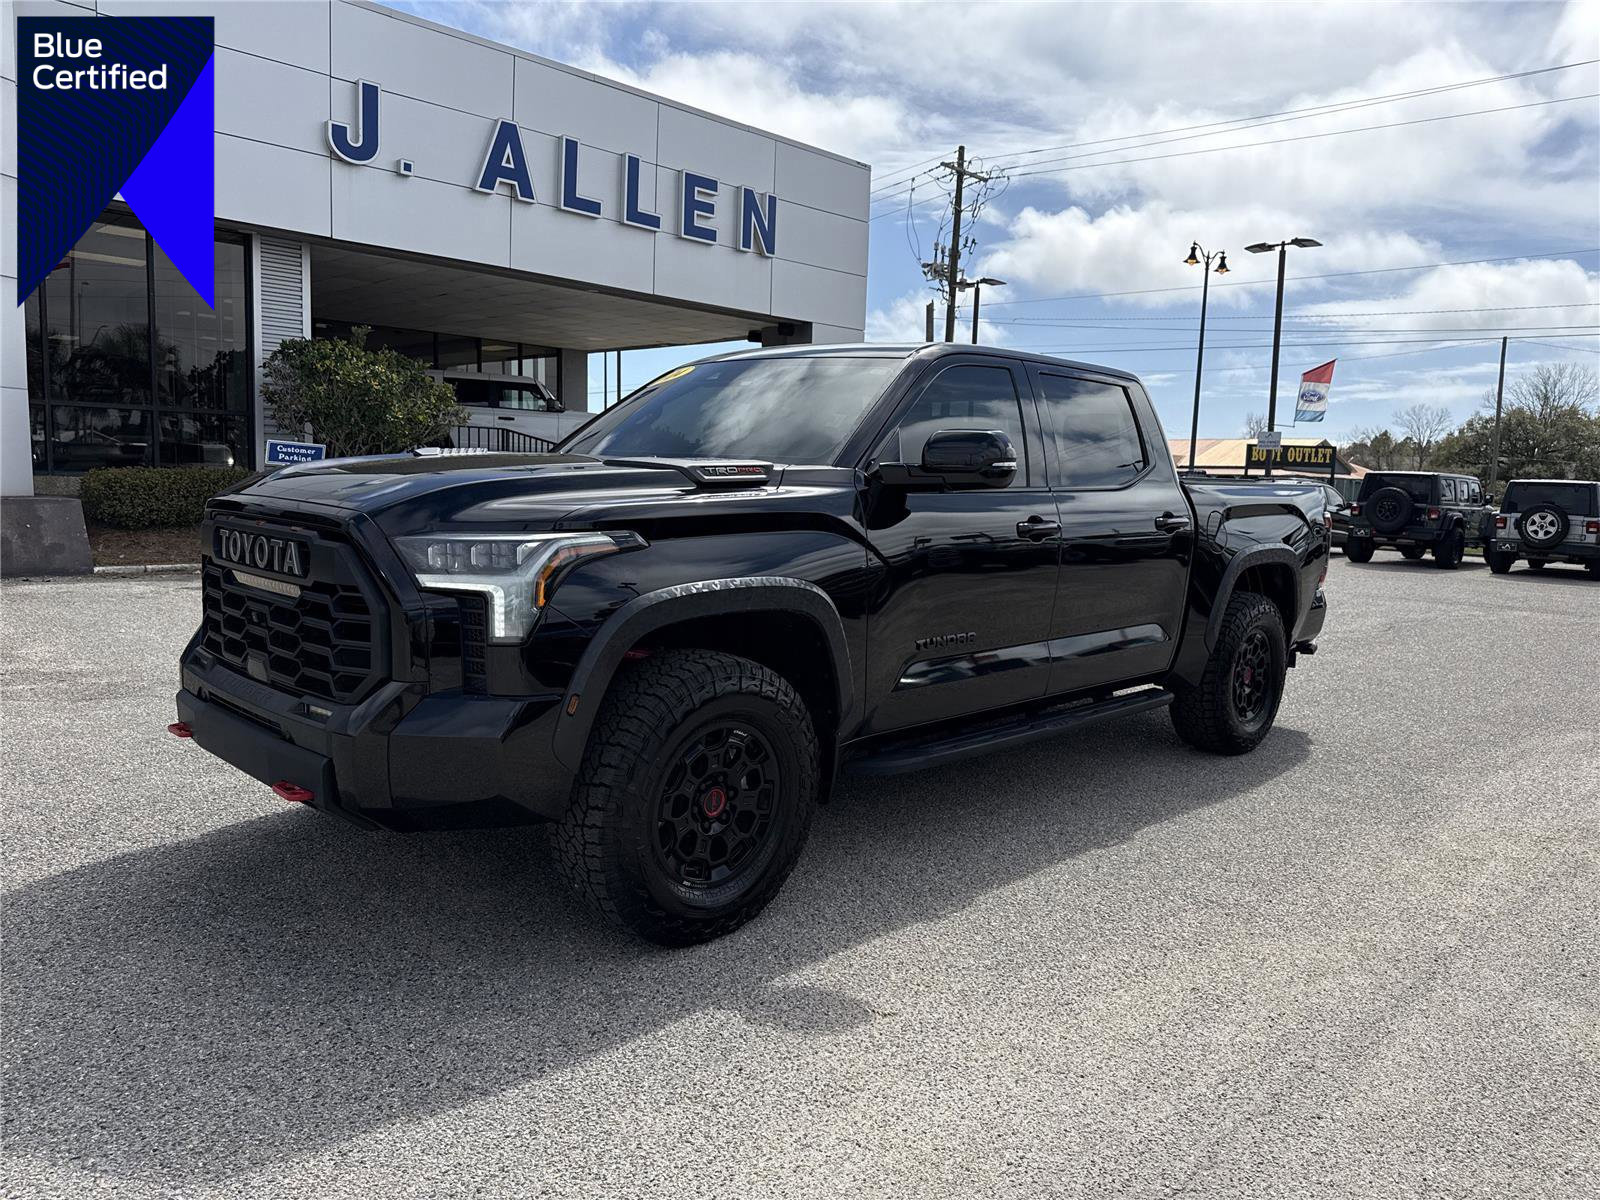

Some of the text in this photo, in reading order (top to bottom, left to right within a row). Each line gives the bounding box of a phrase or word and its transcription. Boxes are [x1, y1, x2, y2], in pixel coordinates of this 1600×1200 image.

[325, 78, 778, 258] J. ALLEN
[276, 445, 316, 455] Customer
[1251, 447, 1333, 463] BOT OUTLET
[219, 528, 303, 576] TOYOTA
[914, 631, 977, 650] TUNDRA
